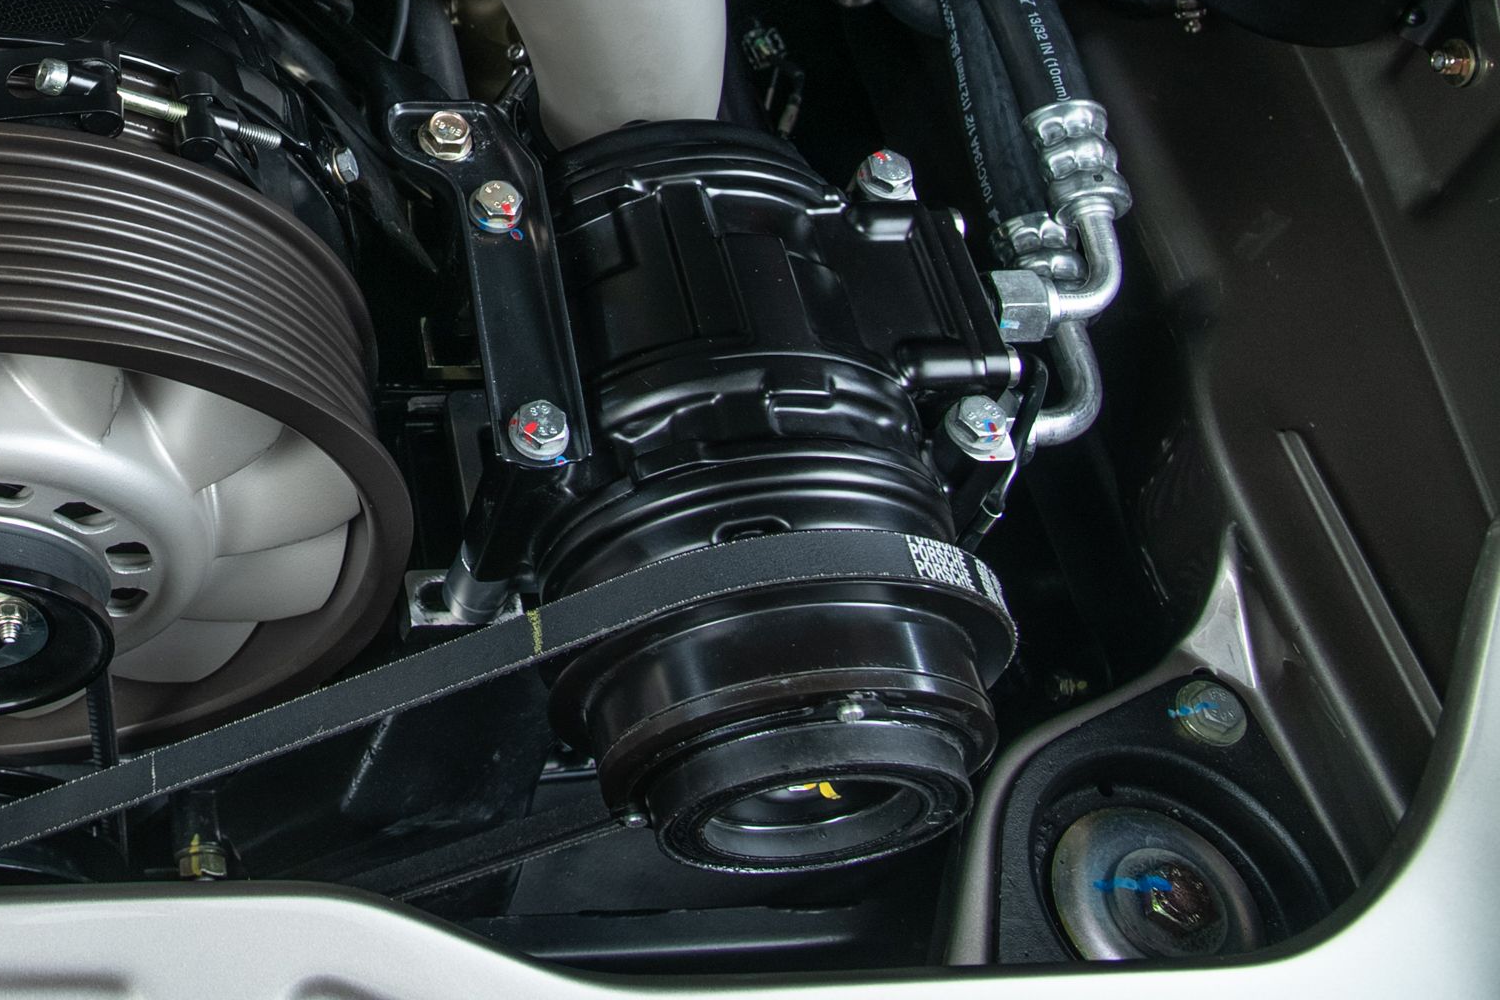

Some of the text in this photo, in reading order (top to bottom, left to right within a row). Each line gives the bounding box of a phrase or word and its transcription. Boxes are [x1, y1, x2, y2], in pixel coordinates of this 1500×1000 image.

[1028, 11, 1048, 41] 13/32
[1040, 42, 1054, 55] IN
[1043, 57, 1071, 101] (10mm)
[908, 543, 971, 576] PORSCHE
[914, 560, 978, 593] PORSCHE
